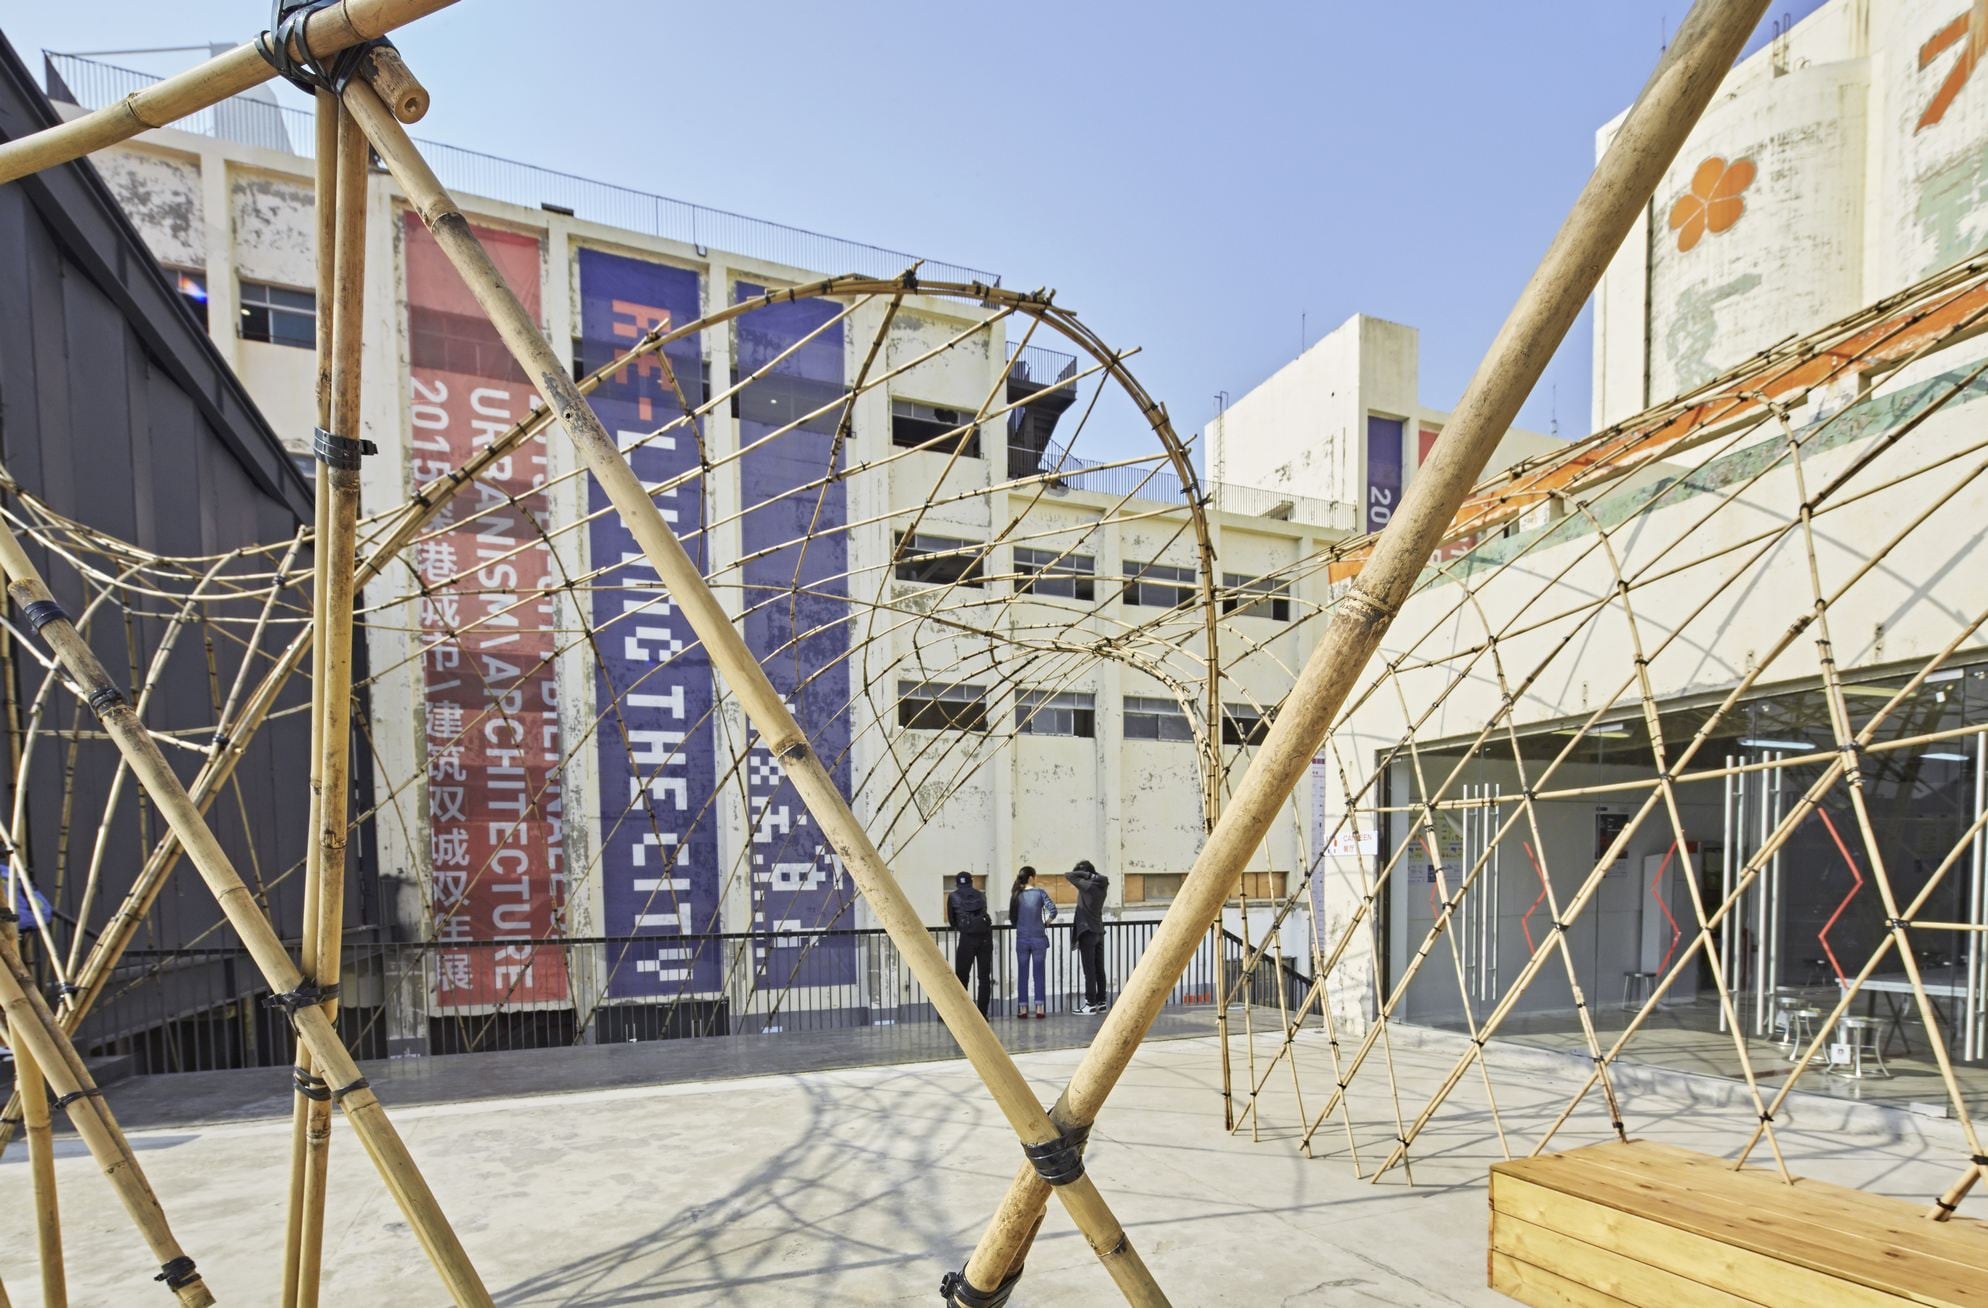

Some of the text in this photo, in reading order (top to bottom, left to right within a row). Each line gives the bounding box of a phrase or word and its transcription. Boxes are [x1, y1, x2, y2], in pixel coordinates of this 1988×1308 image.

[410, 376, 452, 484] 2015
[1370, 486, 1392, 533] 20
[627, 686, 688, 811] THE
[632, 833, 694, 982] CITY
